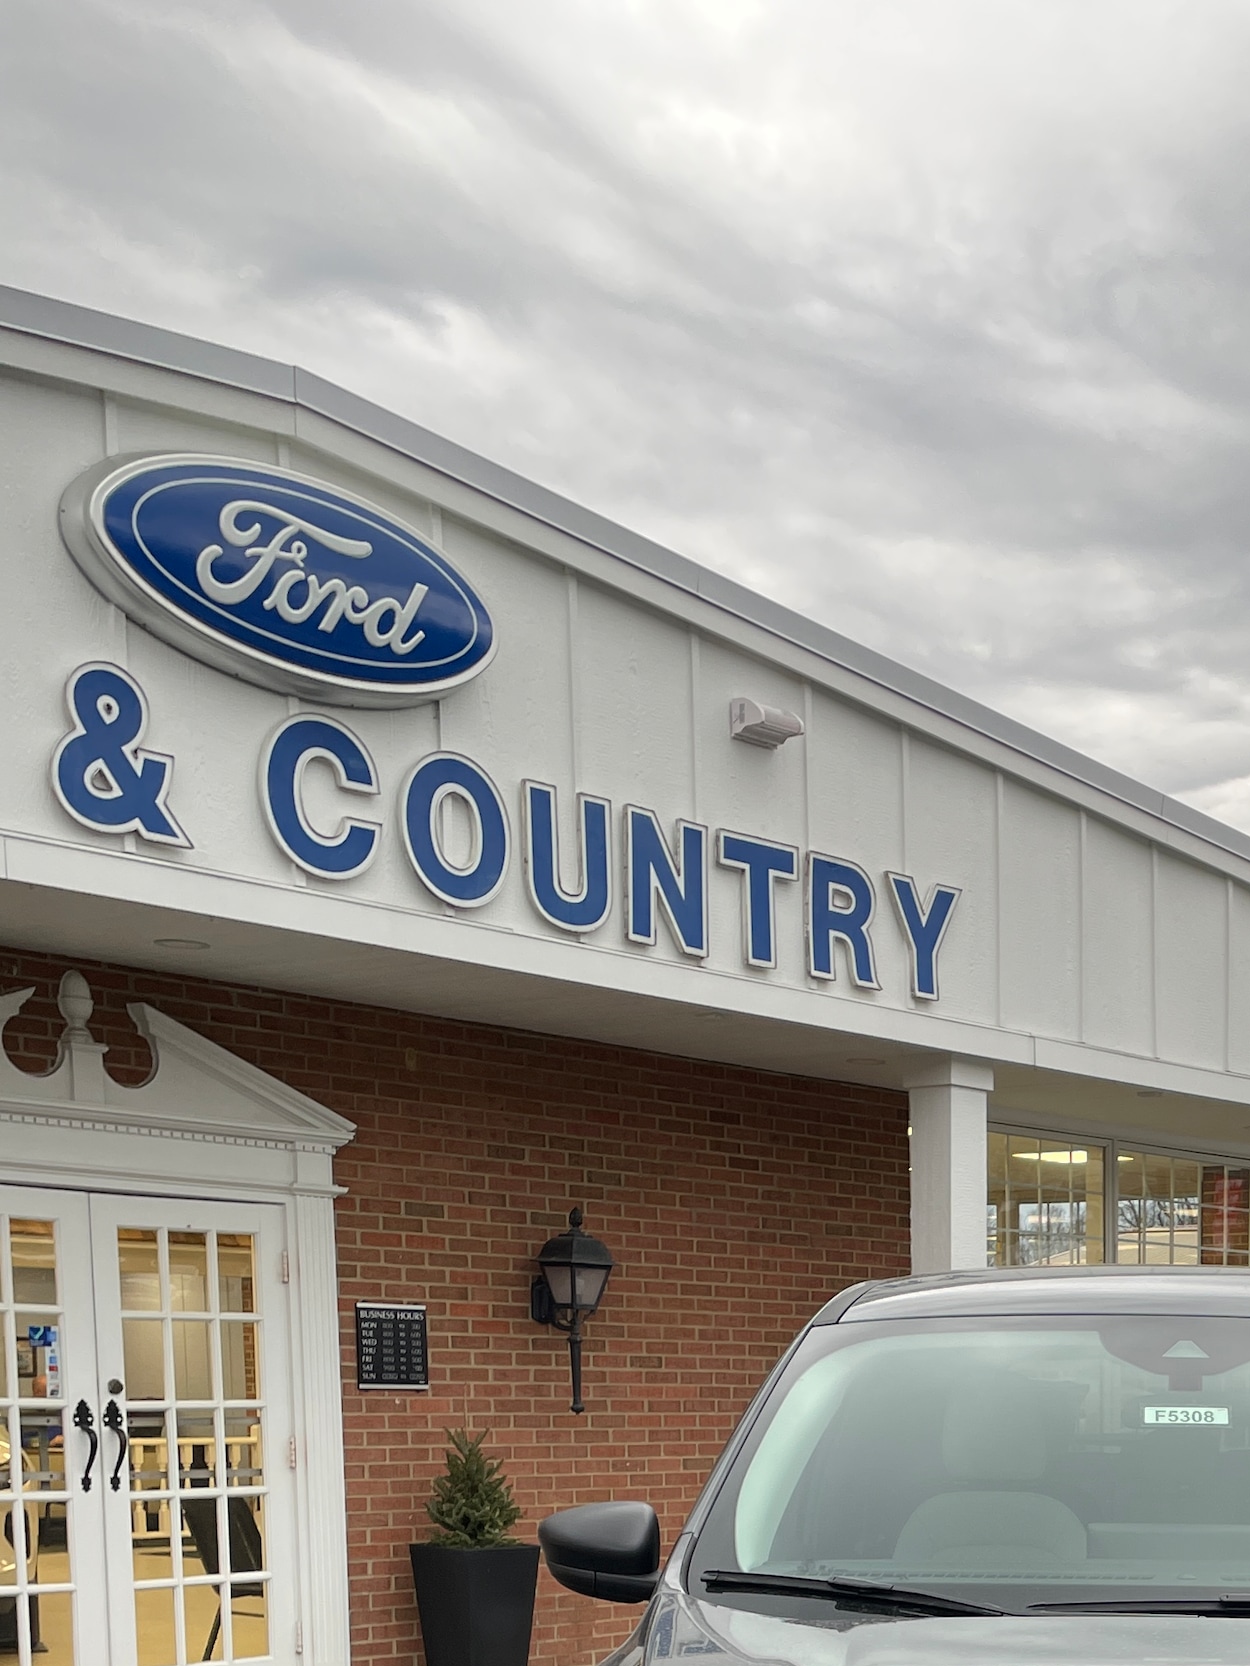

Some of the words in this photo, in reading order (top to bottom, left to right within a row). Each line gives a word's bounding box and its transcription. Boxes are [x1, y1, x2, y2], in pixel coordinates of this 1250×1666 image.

[197, 499, 426, 657] Ford
[51, 660, 194, 849] &
[261, 712, 962, 1001] COUNTRY
[360, 1311, 395, 1319] BUSINESS
[1154, 1409, 1215, 1423] F5308
